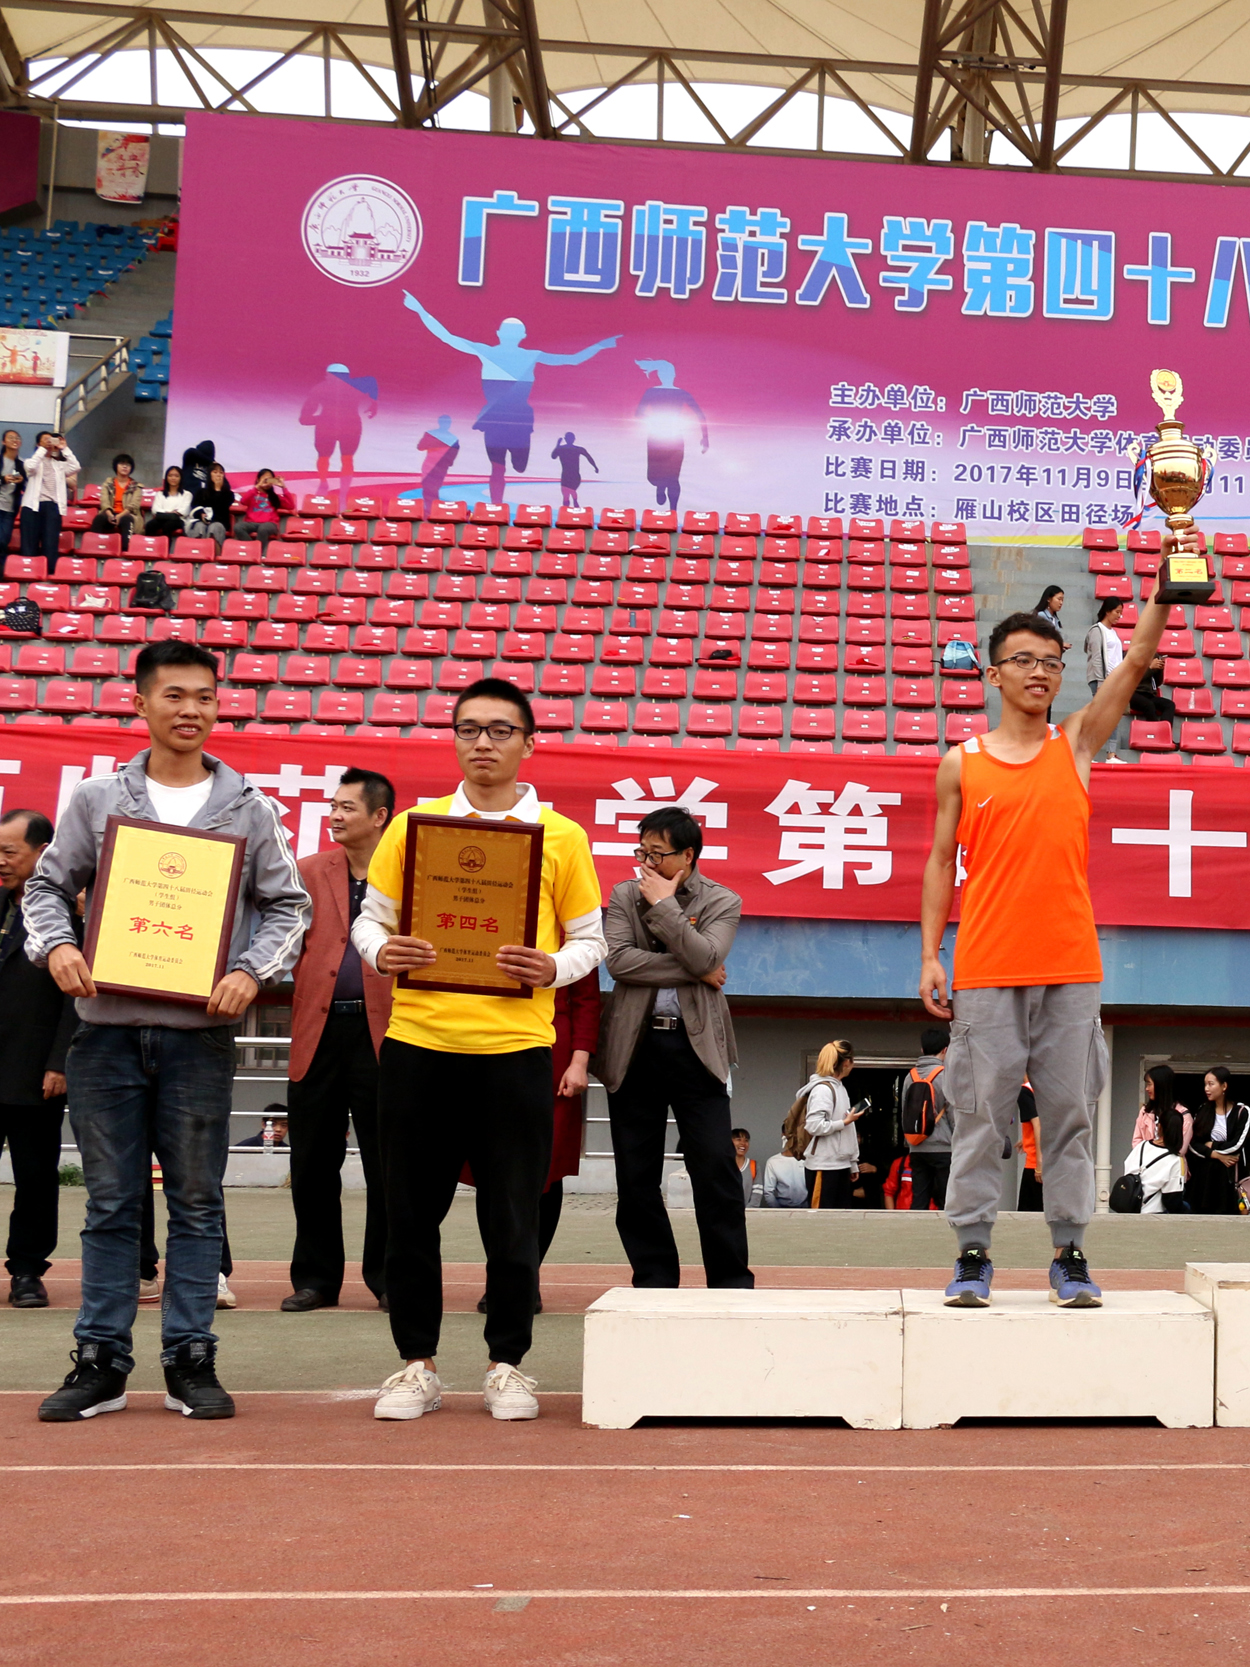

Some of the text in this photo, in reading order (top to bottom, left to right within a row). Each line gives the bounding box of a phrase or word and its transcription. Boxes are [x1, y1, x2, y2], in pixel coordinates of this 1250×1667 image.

[350, 269, 370, 277] 1932
[129, 916, 194, 941] 第六名
[436, 912, 499, 934] 第四名
